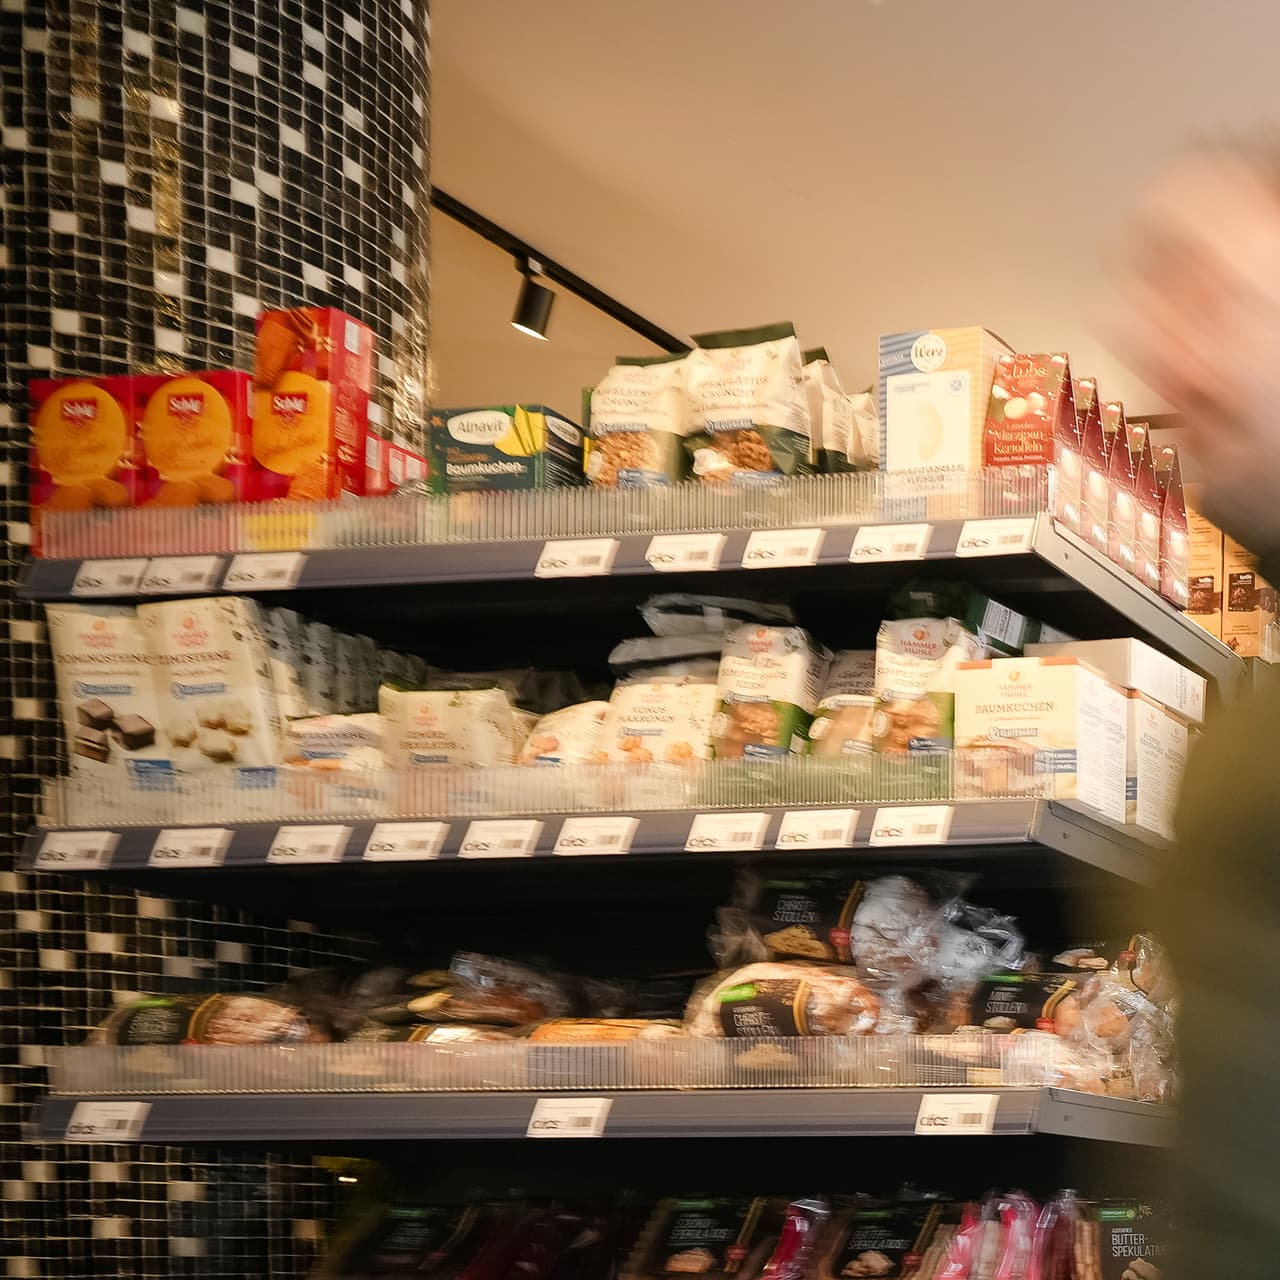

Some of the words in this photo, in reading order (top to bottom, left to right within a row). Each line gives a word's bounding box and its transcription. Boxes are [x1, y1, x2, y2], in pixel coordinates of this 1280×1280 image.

[456, 419, 504, 434] Alnavit
[975, 700, 1055, 714] BAUMKUCHEN
[1111, 1233, 1149, 1246] BUTTER-
